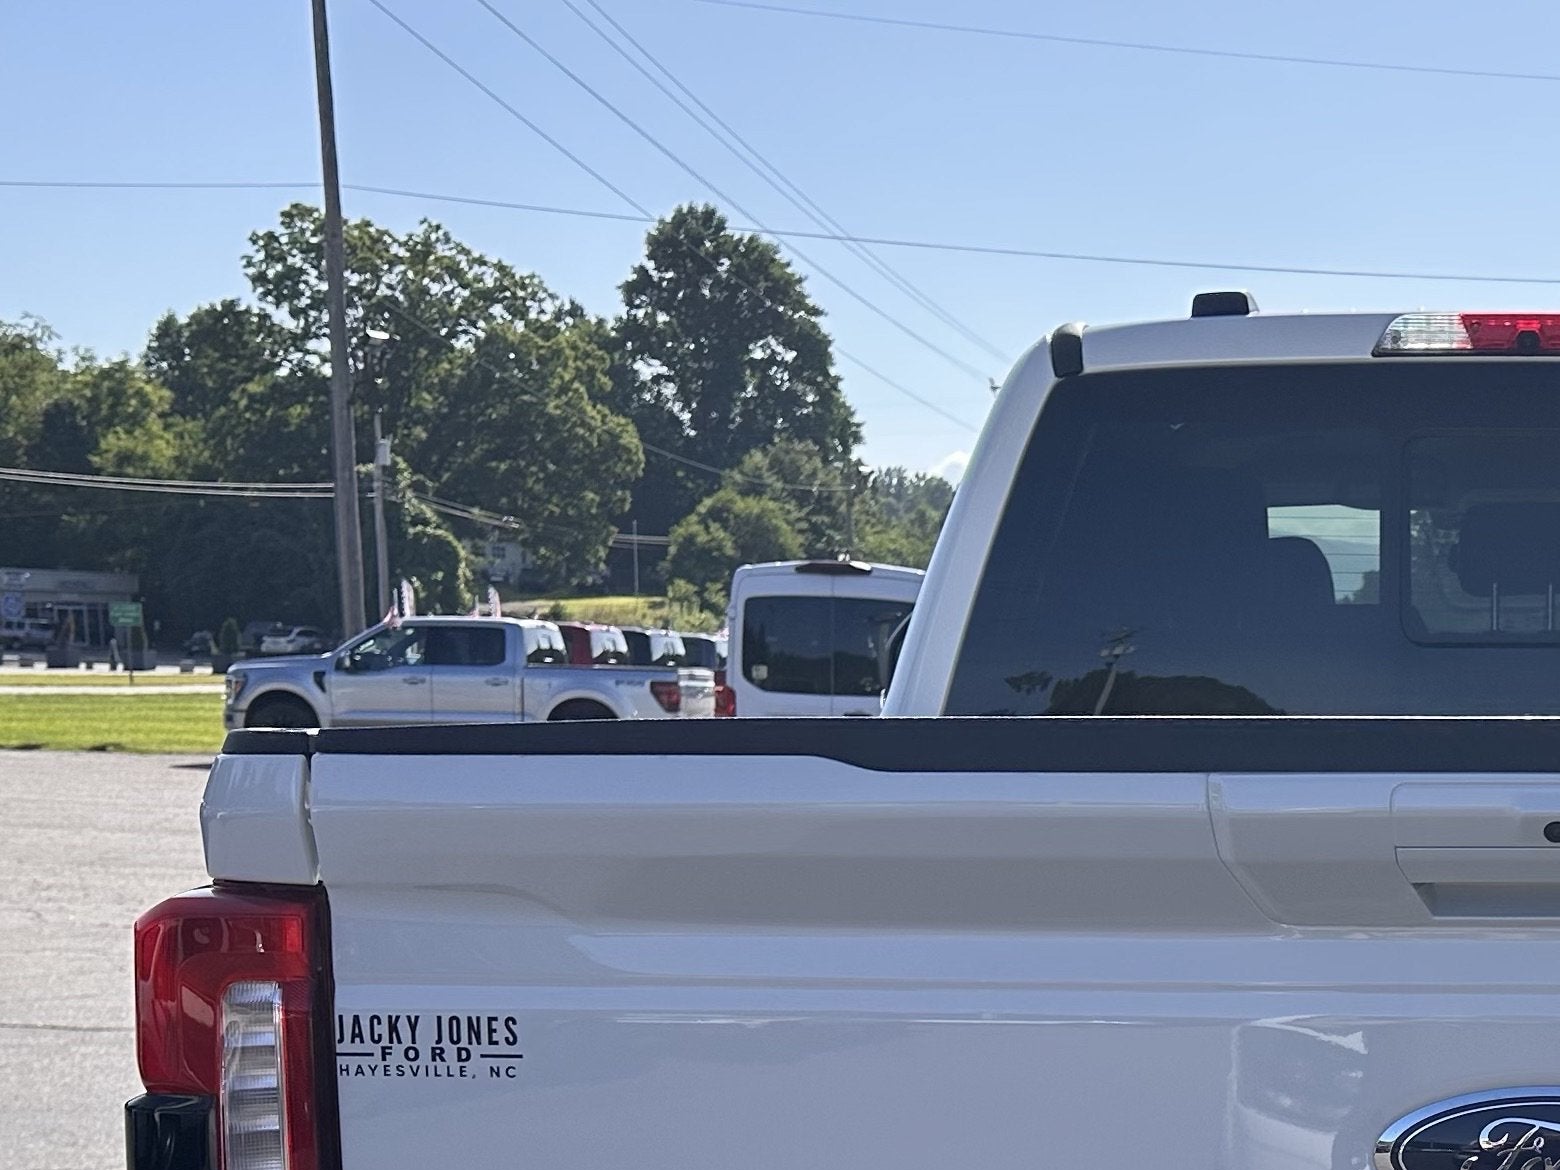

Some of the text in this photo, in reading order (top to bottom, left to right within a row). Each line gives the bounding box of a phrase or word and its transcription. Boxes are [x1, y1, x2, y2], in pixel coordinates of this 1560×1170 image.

[337, 1014, 518, 1046] JACKY JONES
[380, 1045, 472, 1062] FORD
[339, 1063, 517, 1079] HAYESVILLE, NC
